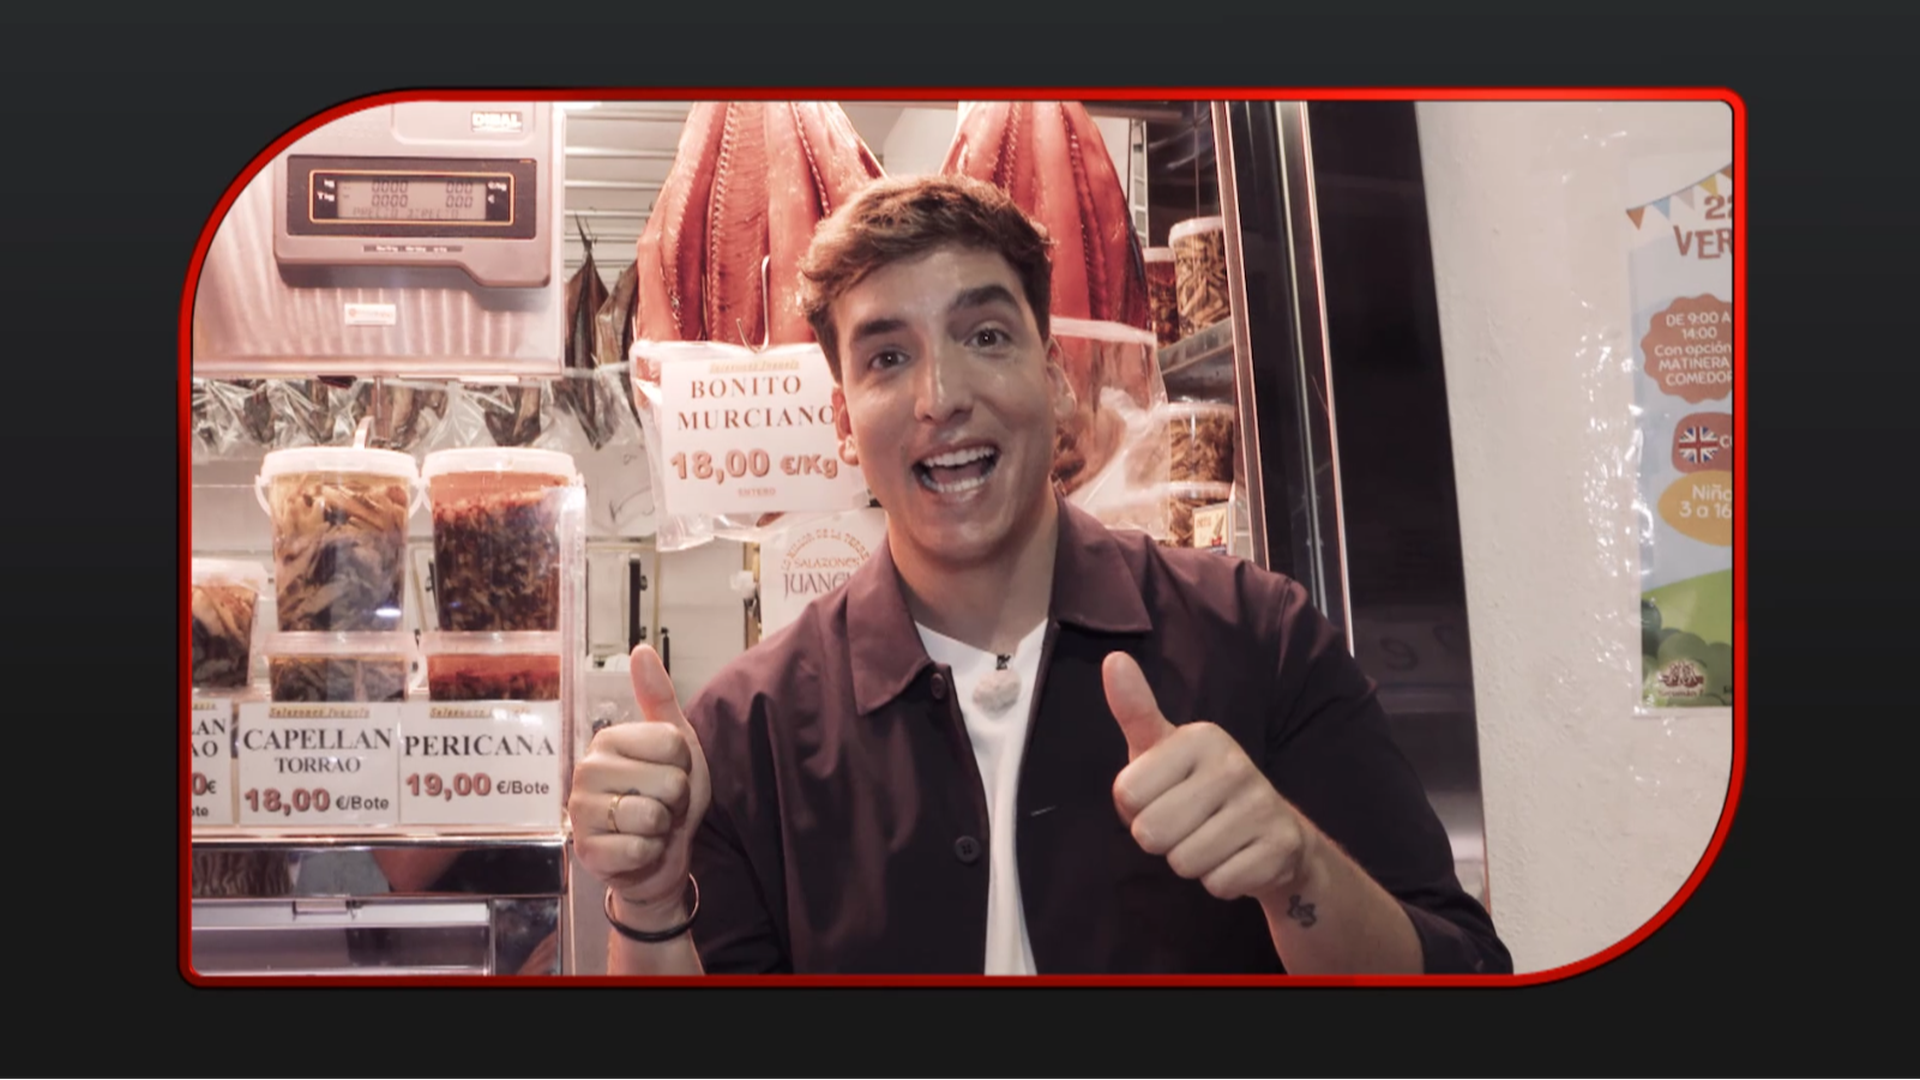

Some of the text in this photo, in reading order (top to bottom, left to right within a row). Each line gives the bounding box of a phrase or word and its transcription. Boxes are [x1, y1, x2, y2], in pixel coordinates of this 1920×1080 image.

[1666, 313, 1685, 327] DE
[1687, 311, 1719, 325] 9:00
[1682, 326, 1717, 340] 14:00
[1654, 344, 1683, 357] Con
[1659, 355, 1729, 371] MATINERA
[691, 374, 801, 399] BONITO
[677, 405, 837, 431] MURCIANO
[1719, 434, 1732, 449] C
[670, 448, 838, 485] 18,00 €/Kg
[1680, 501, 1692, 518] 3
[243, 727, 393, 751] CAPELLAN
[404, 735, 556, 757] PERICANA
[274, 757, 362, 774] TORRAO
[406, 772, 549, 802] 19,00 €/Bote
[245, 787, 389, 817] 18,00 €/Bote
